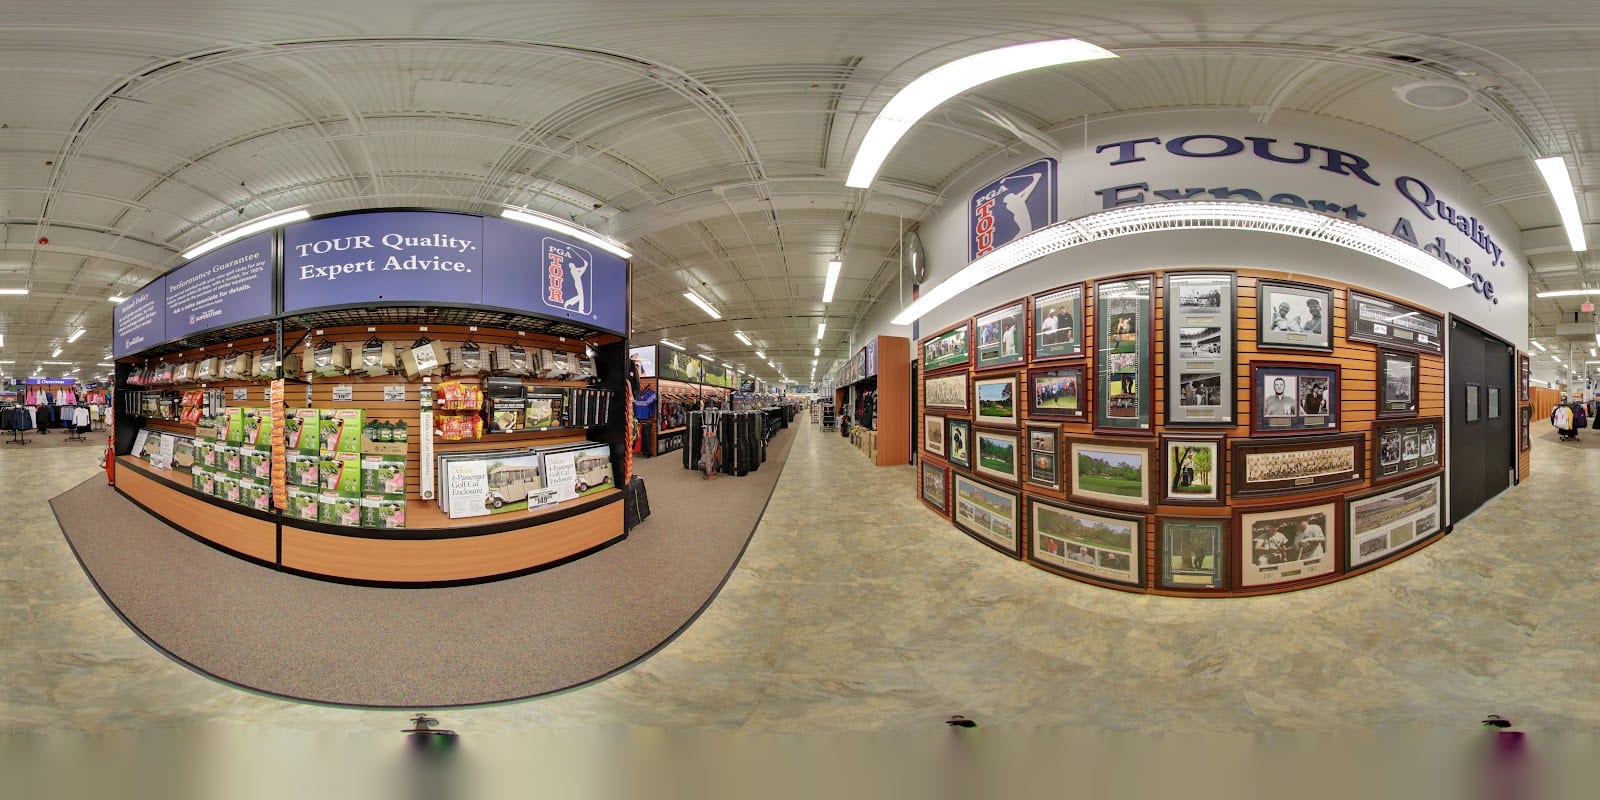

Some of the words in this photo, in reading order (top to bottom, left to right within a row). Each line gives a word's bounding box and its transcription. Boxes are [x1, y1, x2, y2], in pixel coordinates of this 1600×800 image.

[975, 185, 1009, 208] PGA
[1096, 134, 1380, 187] TOUR
[1395, 176, 1505, 267] Quality.
[296, 234, 375, 258] TOUR
[382, 233, 476, 252] Quality.
[549, 245, 572, 259] PGA
[169, 270, 212, 292] Performance
[212, 252, 260, 273] Guarantee
[300, 256, 375, 280] Expert
[382, 255, 472, 273] Advice.
[548, 253, 564, 304] TOUR
[228, 284, 252, 294] details.
